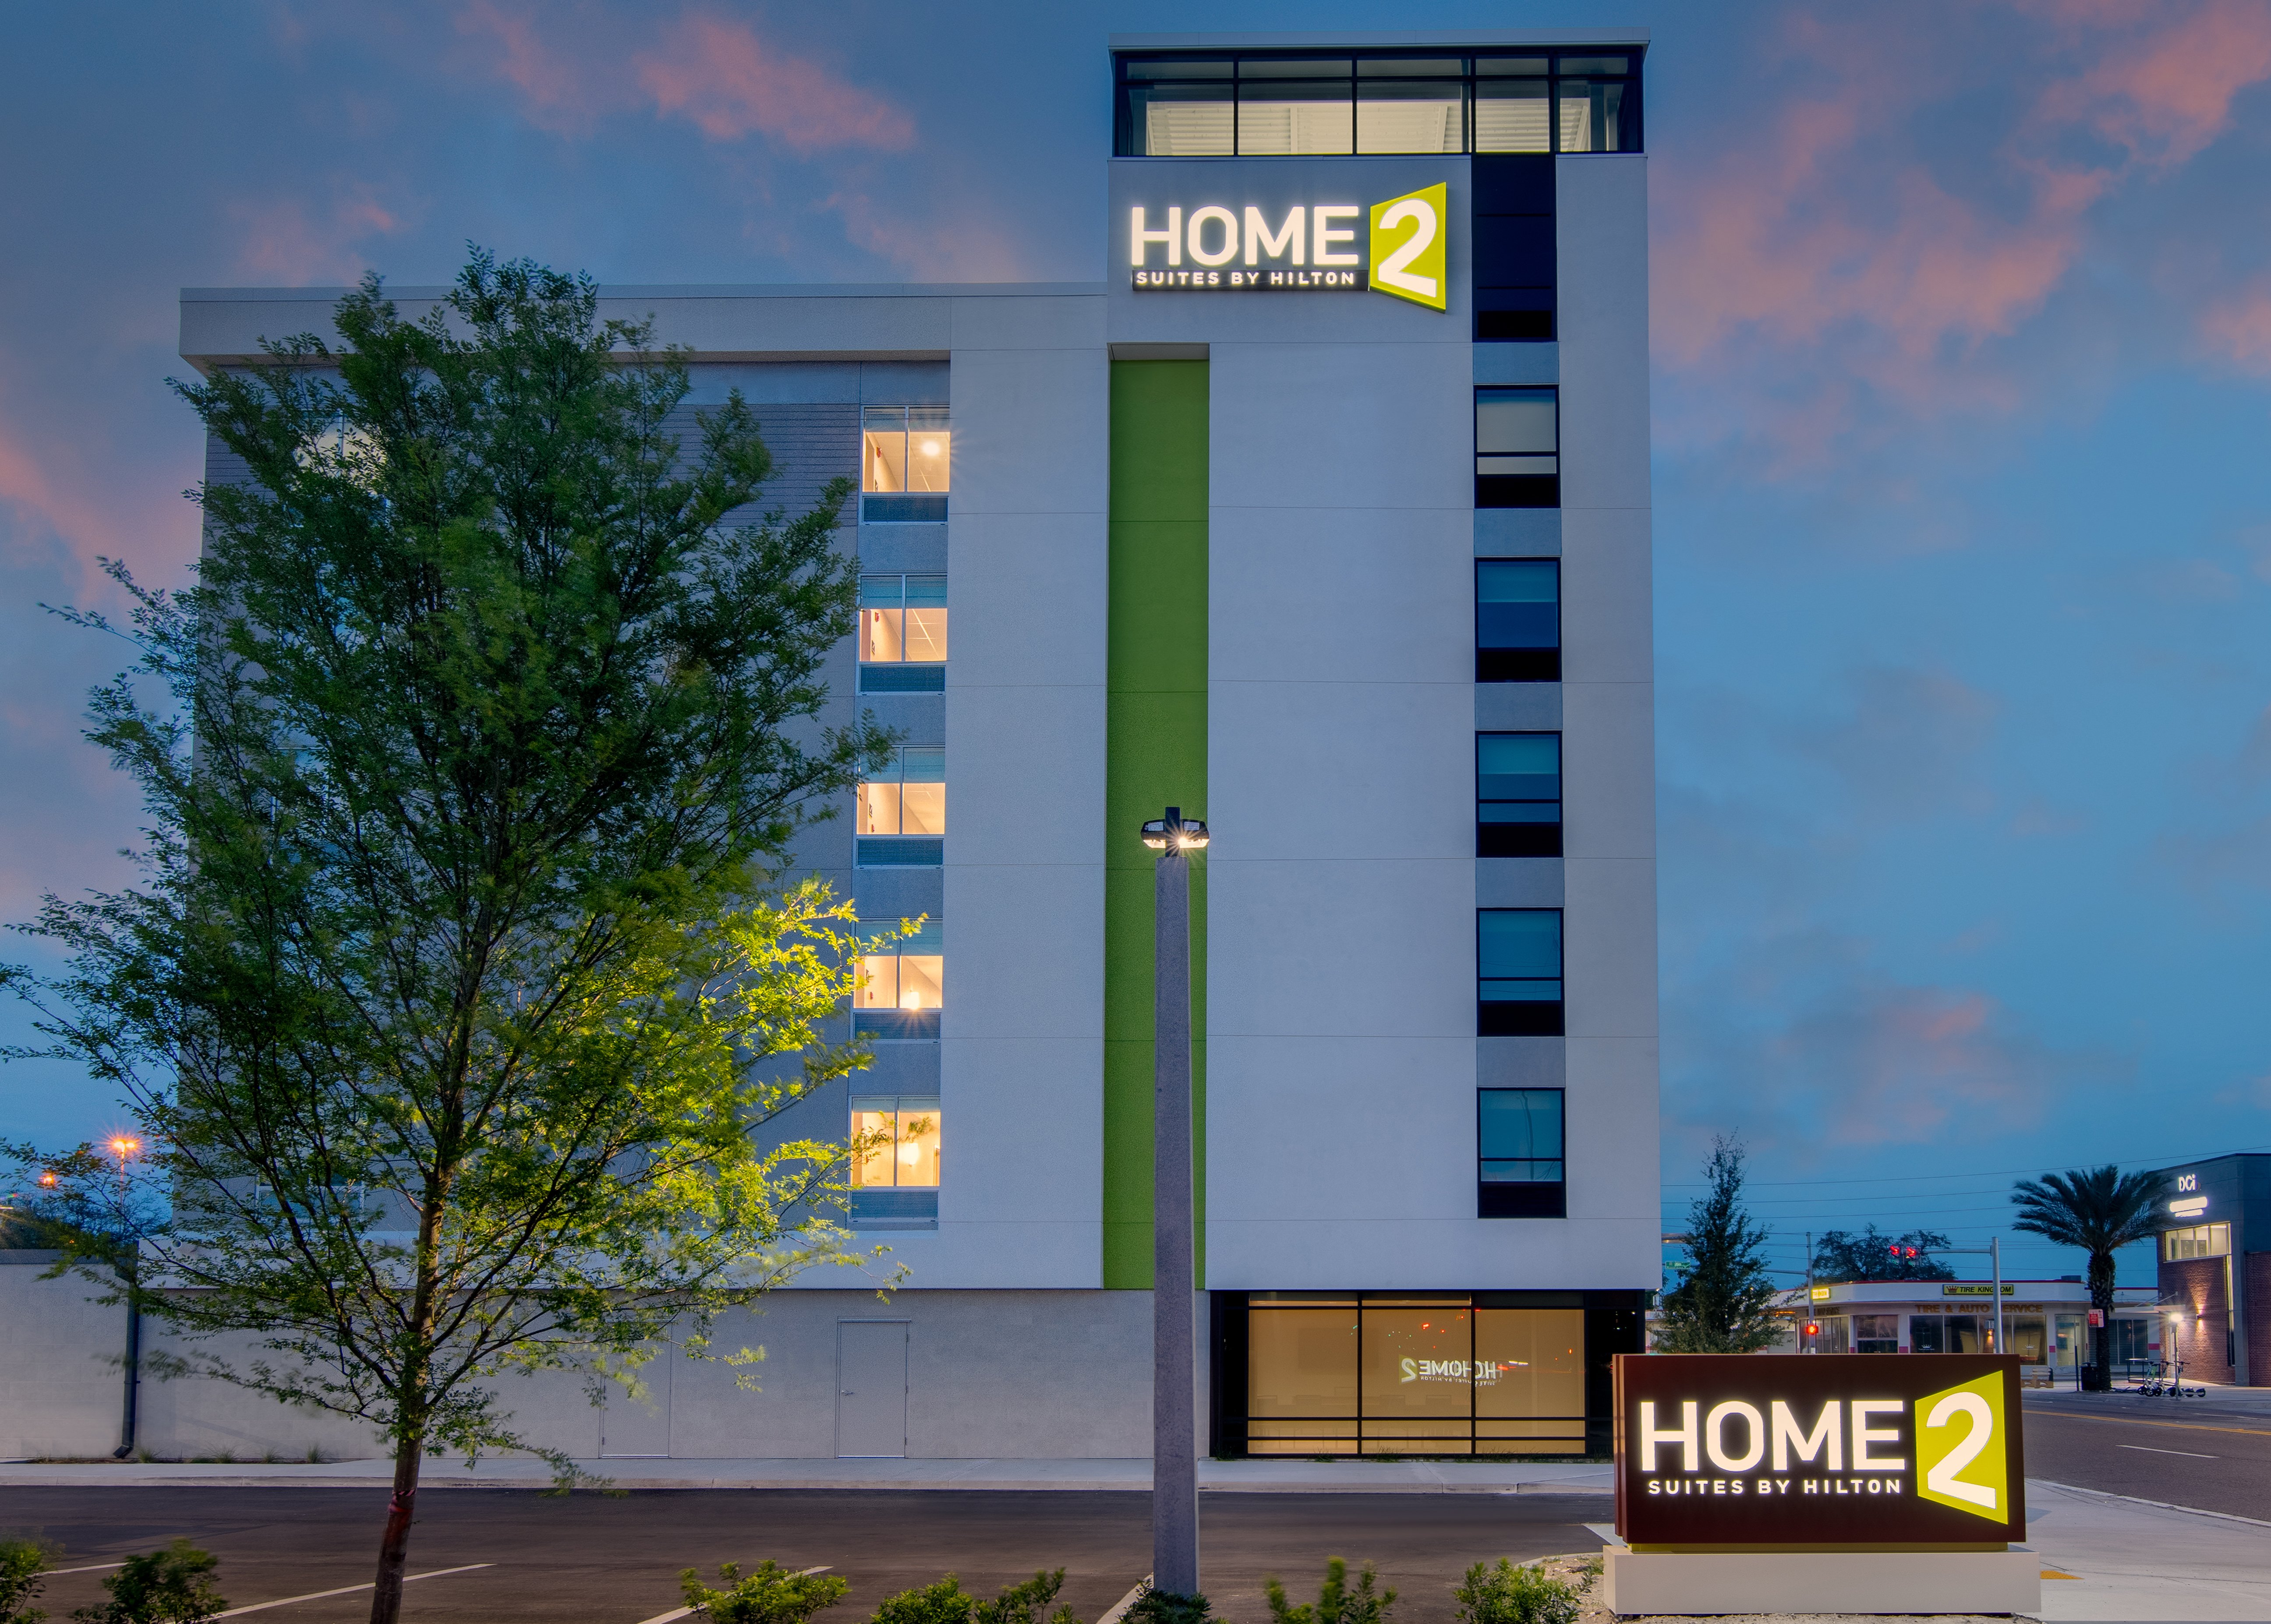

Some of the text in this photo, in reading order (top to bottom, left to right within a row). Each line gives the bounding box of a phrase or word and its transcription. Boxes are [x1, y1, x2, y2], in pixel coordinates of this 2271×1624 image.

[1131, 198, 1437, 298] HOME 2
[1136, 271, 1354, 285] SUITES BY HILTON
[1914, 1304, 2043, 1313] TIRE & AUTO ERVICE
[1641, 1391, 1996, 1510] HOME 2
[1648, 1479, 1900, 1495] SUITES BY HILTON
